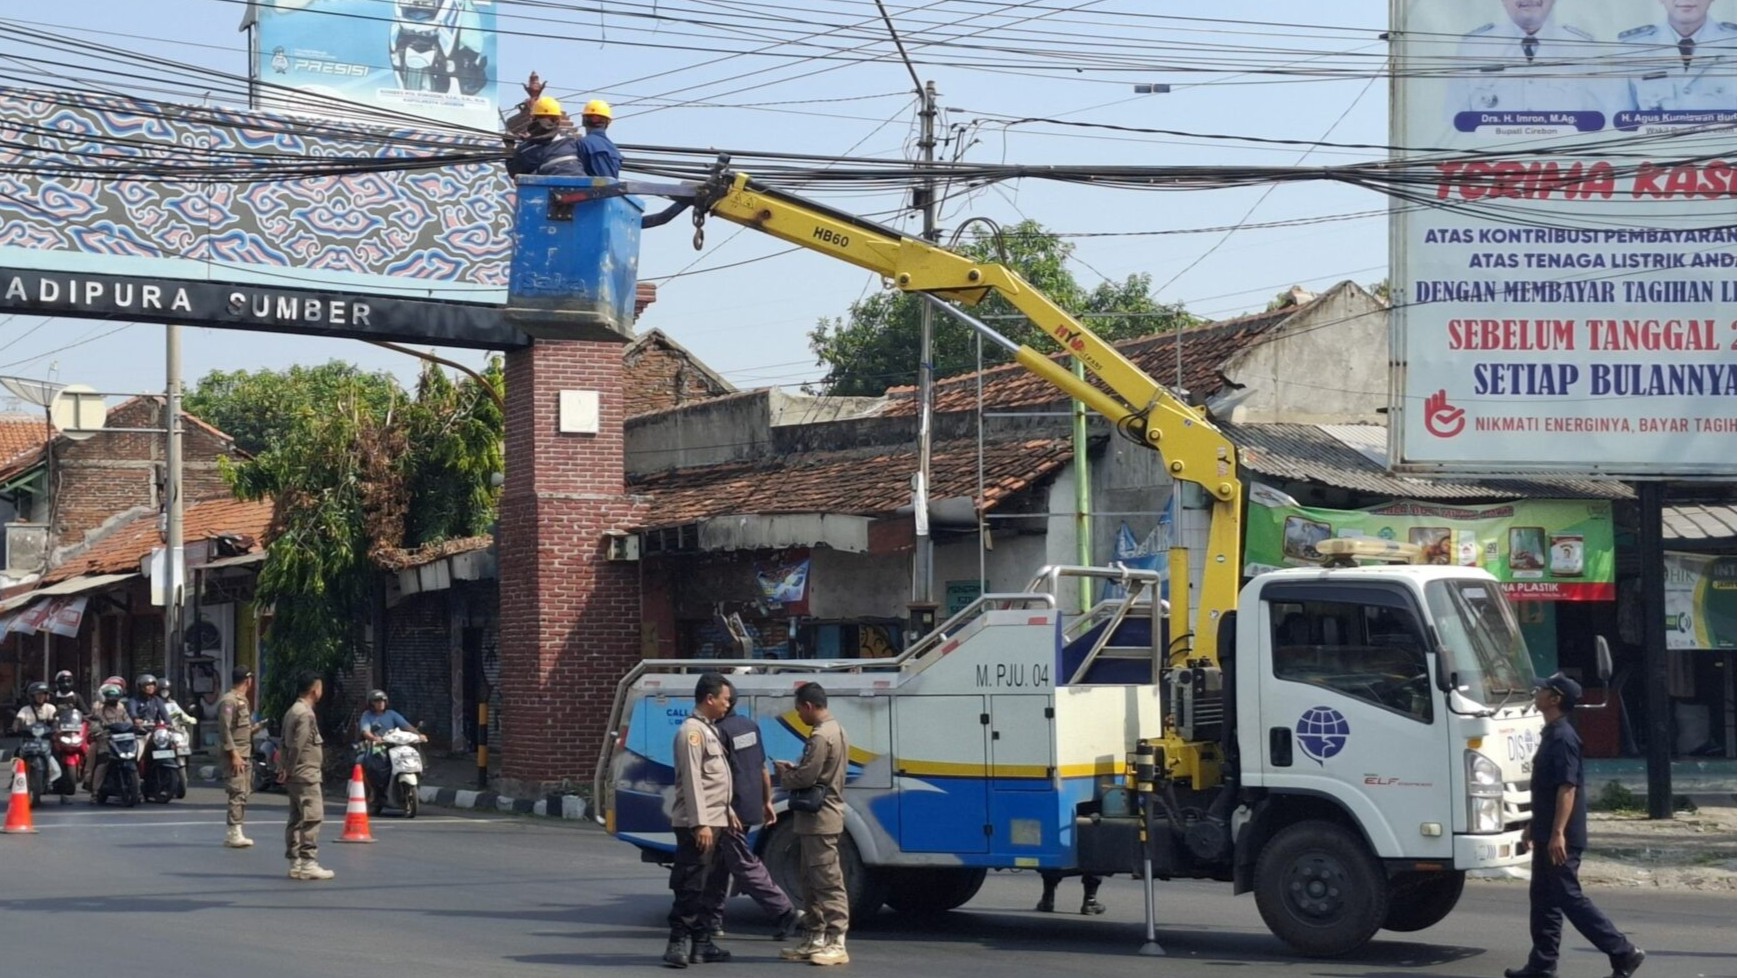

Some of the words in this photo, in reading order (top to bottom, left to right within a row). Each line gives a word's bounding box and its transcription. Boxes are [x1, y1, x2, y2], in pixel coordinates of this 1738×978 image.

[295, 58, 369, 77] PRESISI
[1481, 113, 1502, 124] Drs.
[1504, 113, 1514, 124] H.
[1516, 113, 1546, 125] Imron,
[1635, 113, 1659, 124] Agus
[1495, 127, 1522, 136] Bupati
[1524, 127, 1557, 135] Cirebon
[813, 226, 850, 248] HB60
[1424, 228, 1474, 244] ATAS
[1479, 228, 1599, 244] KONTRIBUSI
[1604, 228, 1737, 244] PEMBAYARAN
[1468, 253, 1519, 268] ATAS
[1524, 253, 1606, 268] TENAGA
[1611, 253, 1686, 268] LISTRIK
[1690, 253, 1737, 268] AND
[1416, 281, 1496, 303] DENGAN
[1503, 281, 1615, 303] MEMBAYAR
[1623, 280, 1713, 303] TAGIHAN
[5, 276, 192, 312] ADIPURA
[227, 291, 371, 327] SUMBER
[1449, 319, 1575, 350] SEBELUM
[1585, 319, 1720, 351] TANGGAL
[1474, 363, 1579, 396] SETIAP
[1475, 417, 1539, 433] NIKMATI
[1545, 417, 1635, 435] ENERGINYA,
[1639, 417, 1689, 433] BAYAR
[1517, 583, 1559, 592] PLASTIK
[976, 664, 992, 687] M.
[997, 663, 1028, 687] PJU.
[1033, 663, 1049, 687] 04
[1364, 776, 1400, 786] ELF
